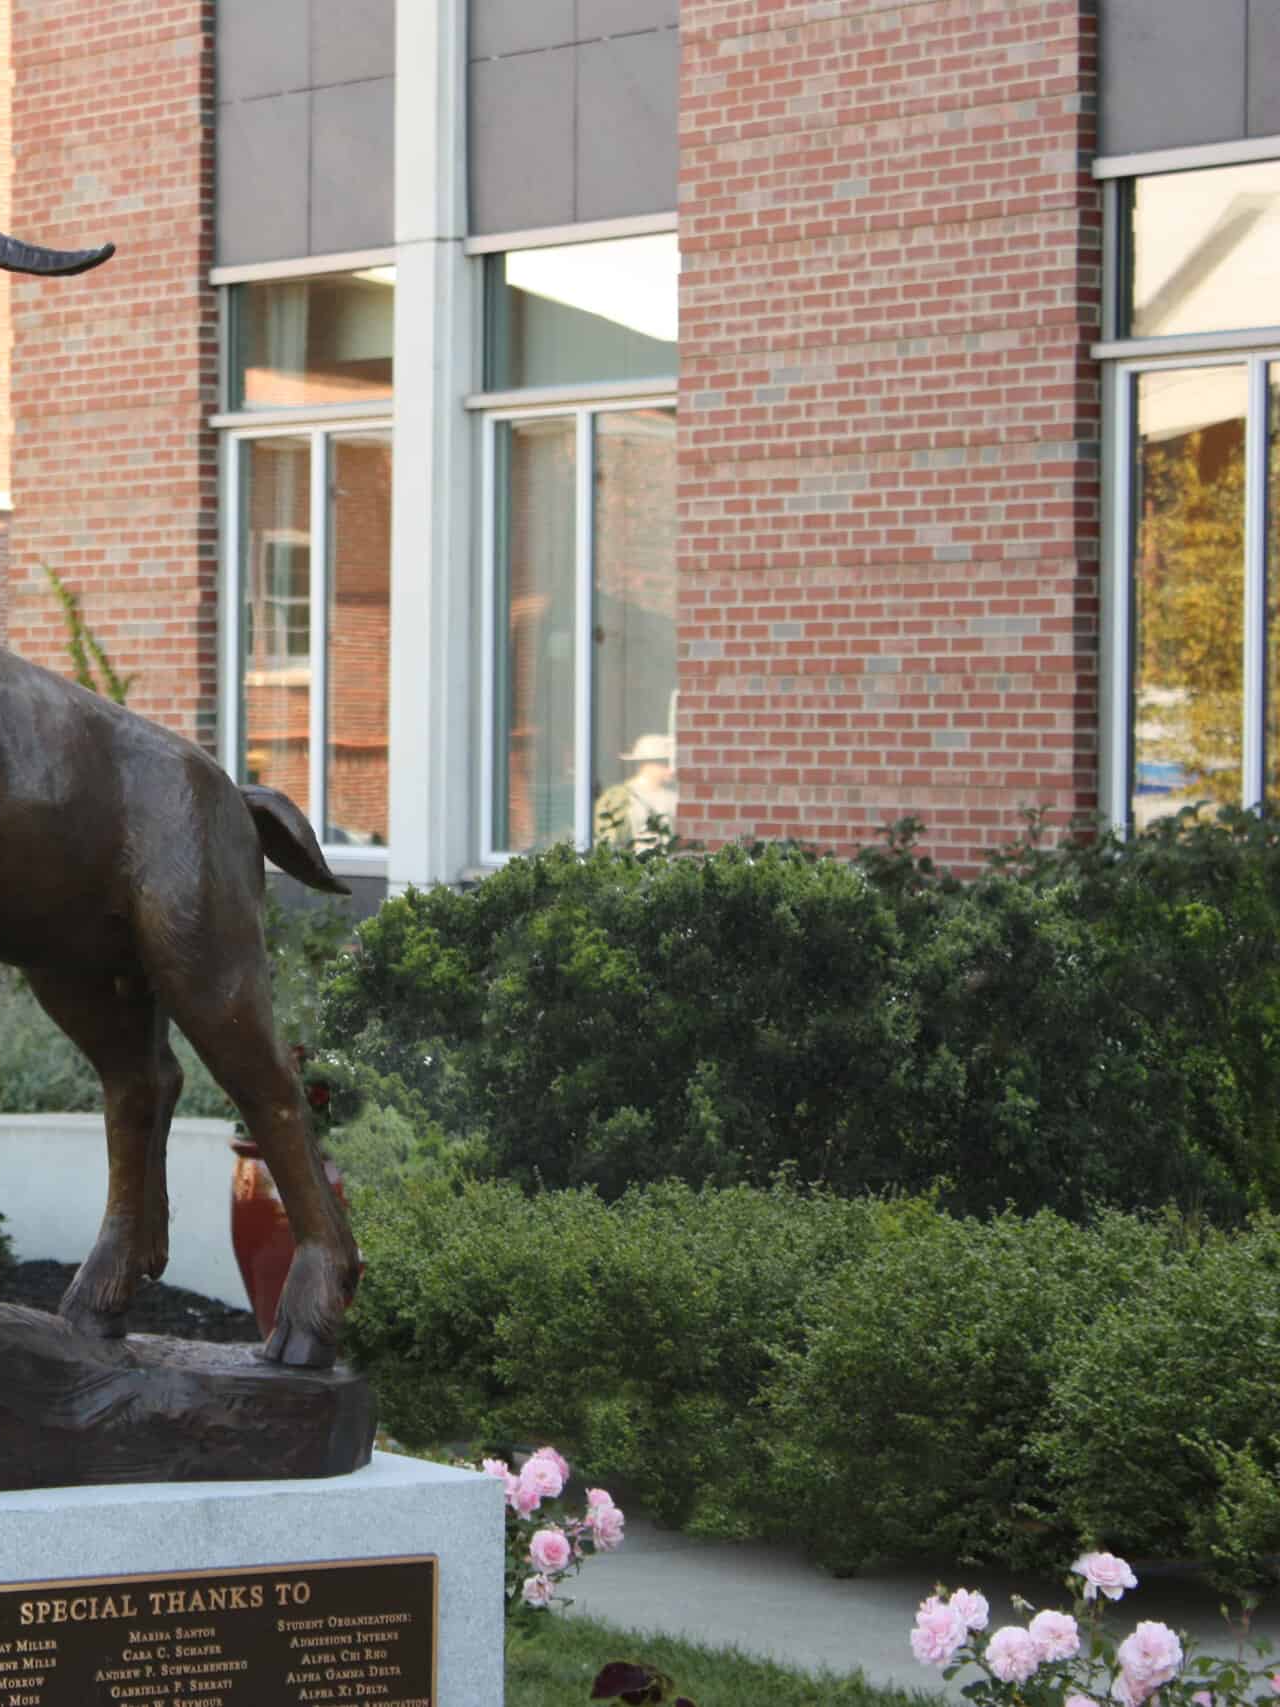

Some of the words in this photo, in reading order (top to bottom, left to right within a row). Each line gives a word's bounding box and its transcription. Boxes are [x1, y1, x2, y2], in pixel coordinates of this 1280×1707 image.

[20, 1595, 138, 1625] SPECIAL
[149, 1585, 264, 1616] THANKS
[275, 1582, 311, 1605] TO
[277, 1619, 323, 1632] STUDENT
[175, 1627, 216, 1640] SANTOS
[289, 1635, 352, 1649] ADMISSIONS
[356, 1631, 399, 1643] INTERNS
[16, 1640, 57, 1653] MILLER
[122, 1649, 152, 1662] CARA
[301, 1653, 336, 1665] ALPHA
[340, 1650, 360, 1662] CHI
[365, 1648, 387, 1660] RHO
[23, 1657, 57, 1670] MILLS
[95, 1668, 140, 1682] ANDREW
[286, 1672, 320, 1684] ALPHA
[325, 1669, 364, 1681] GAMMA
[369, 1666, 401, 1678] DELTA
[299, 1688, 334, 1700] ALPHA
[338, 1685, 352, 1697] XI
[356, 1683, 388, 1696] DELTA
[9, 1694, 40, 1707] MOSS
